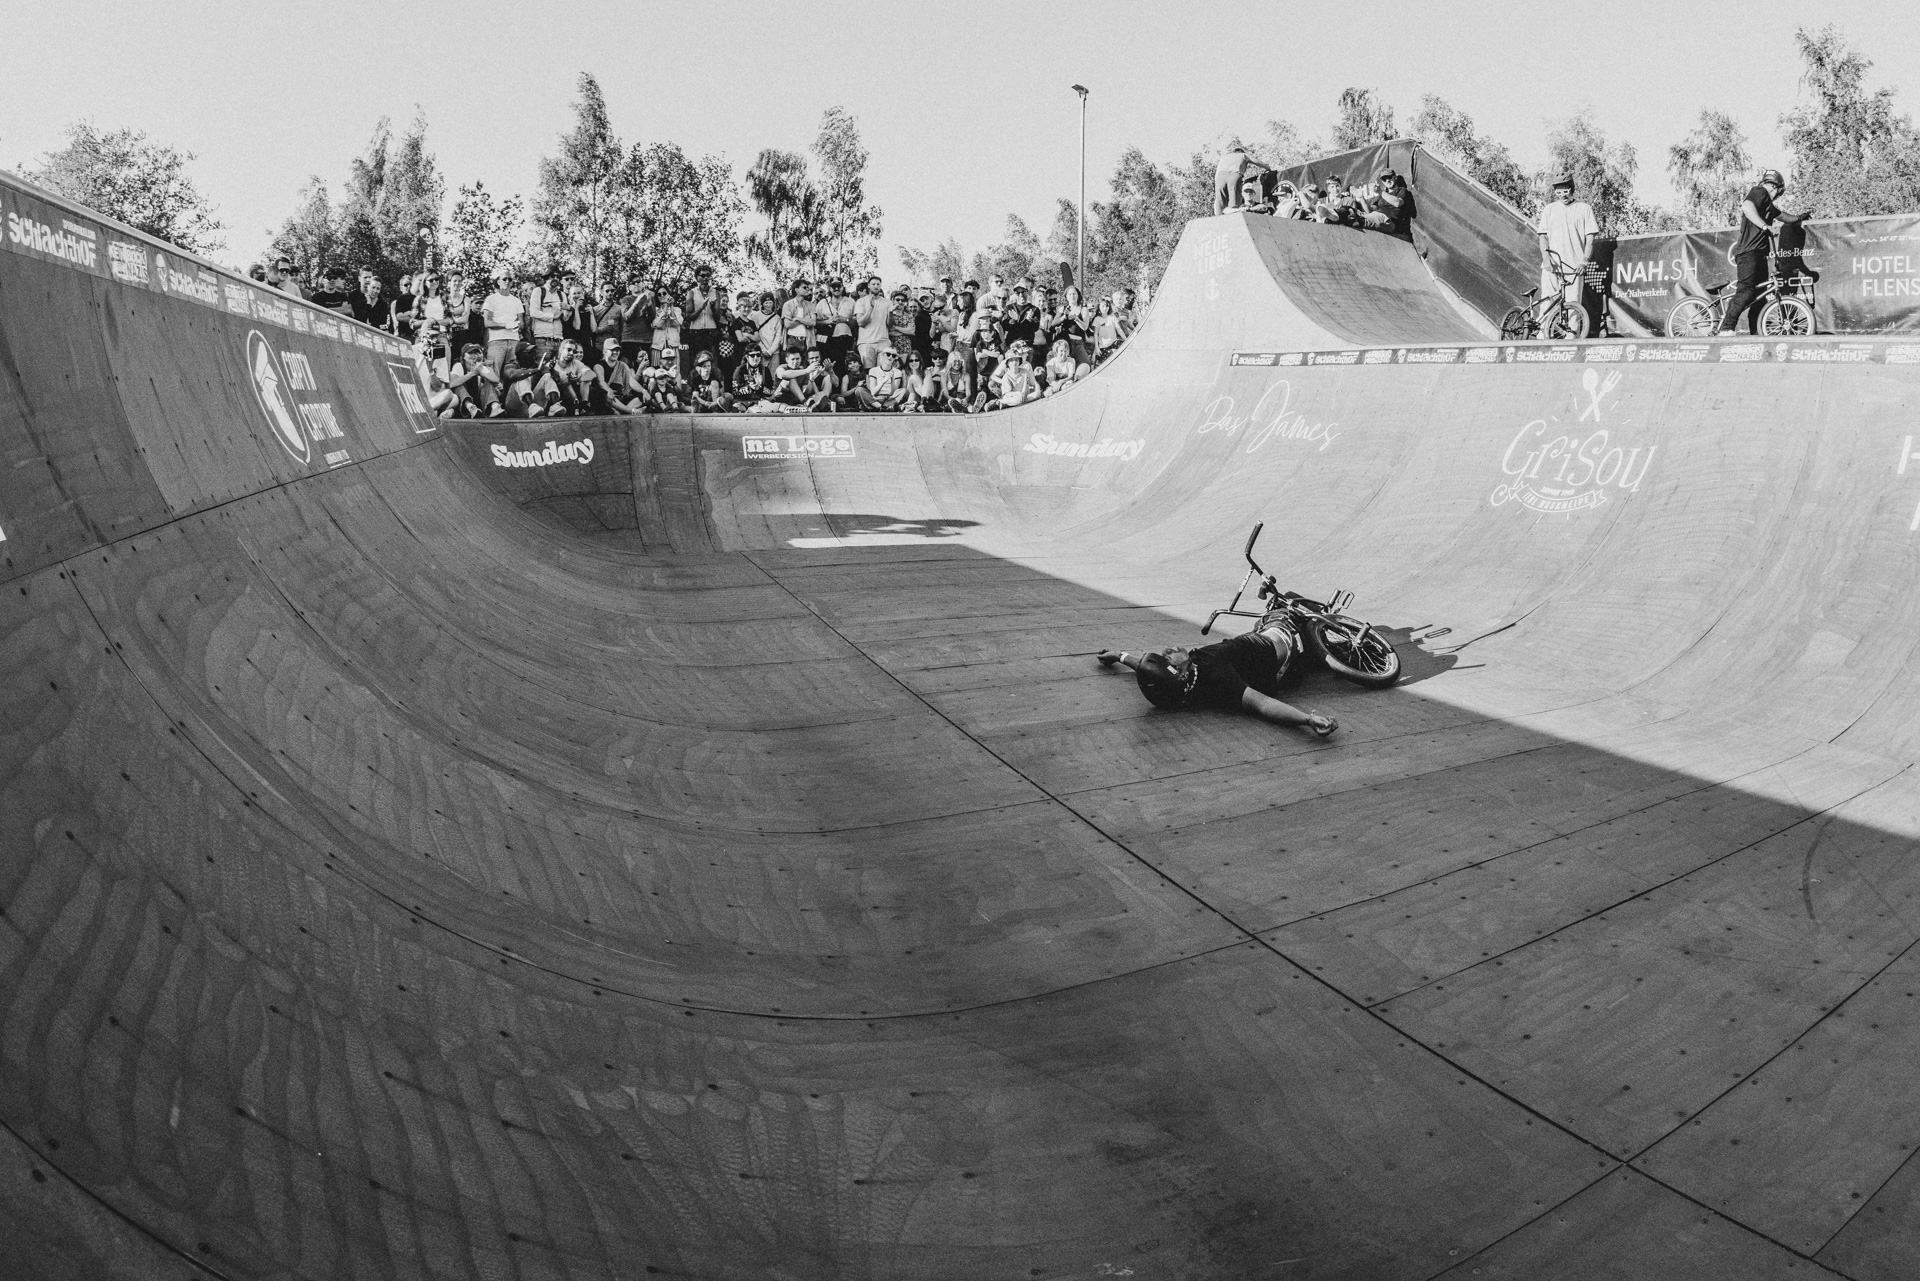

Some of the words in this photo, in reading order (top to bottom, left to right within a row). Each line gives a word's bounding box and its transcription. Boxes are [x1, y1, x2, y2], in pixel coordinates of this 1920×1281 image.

[1616, 258, 1698, 285] NAH.SH
[1852, 255, 1916, 275] HOTEL
[1614, 290, 1628, 299] Der
[1629, 287, 1668, 298] Nahverkehr
[1198, 393, 1249, 436] Das
[1247, 379, 1342, 453] James
[490, 438, 594, 468] Sunday
[746, 439, 780, 453] na
[787, 436, 850, 455] Logo
[1024, 432, 1146, 461] Sunday
